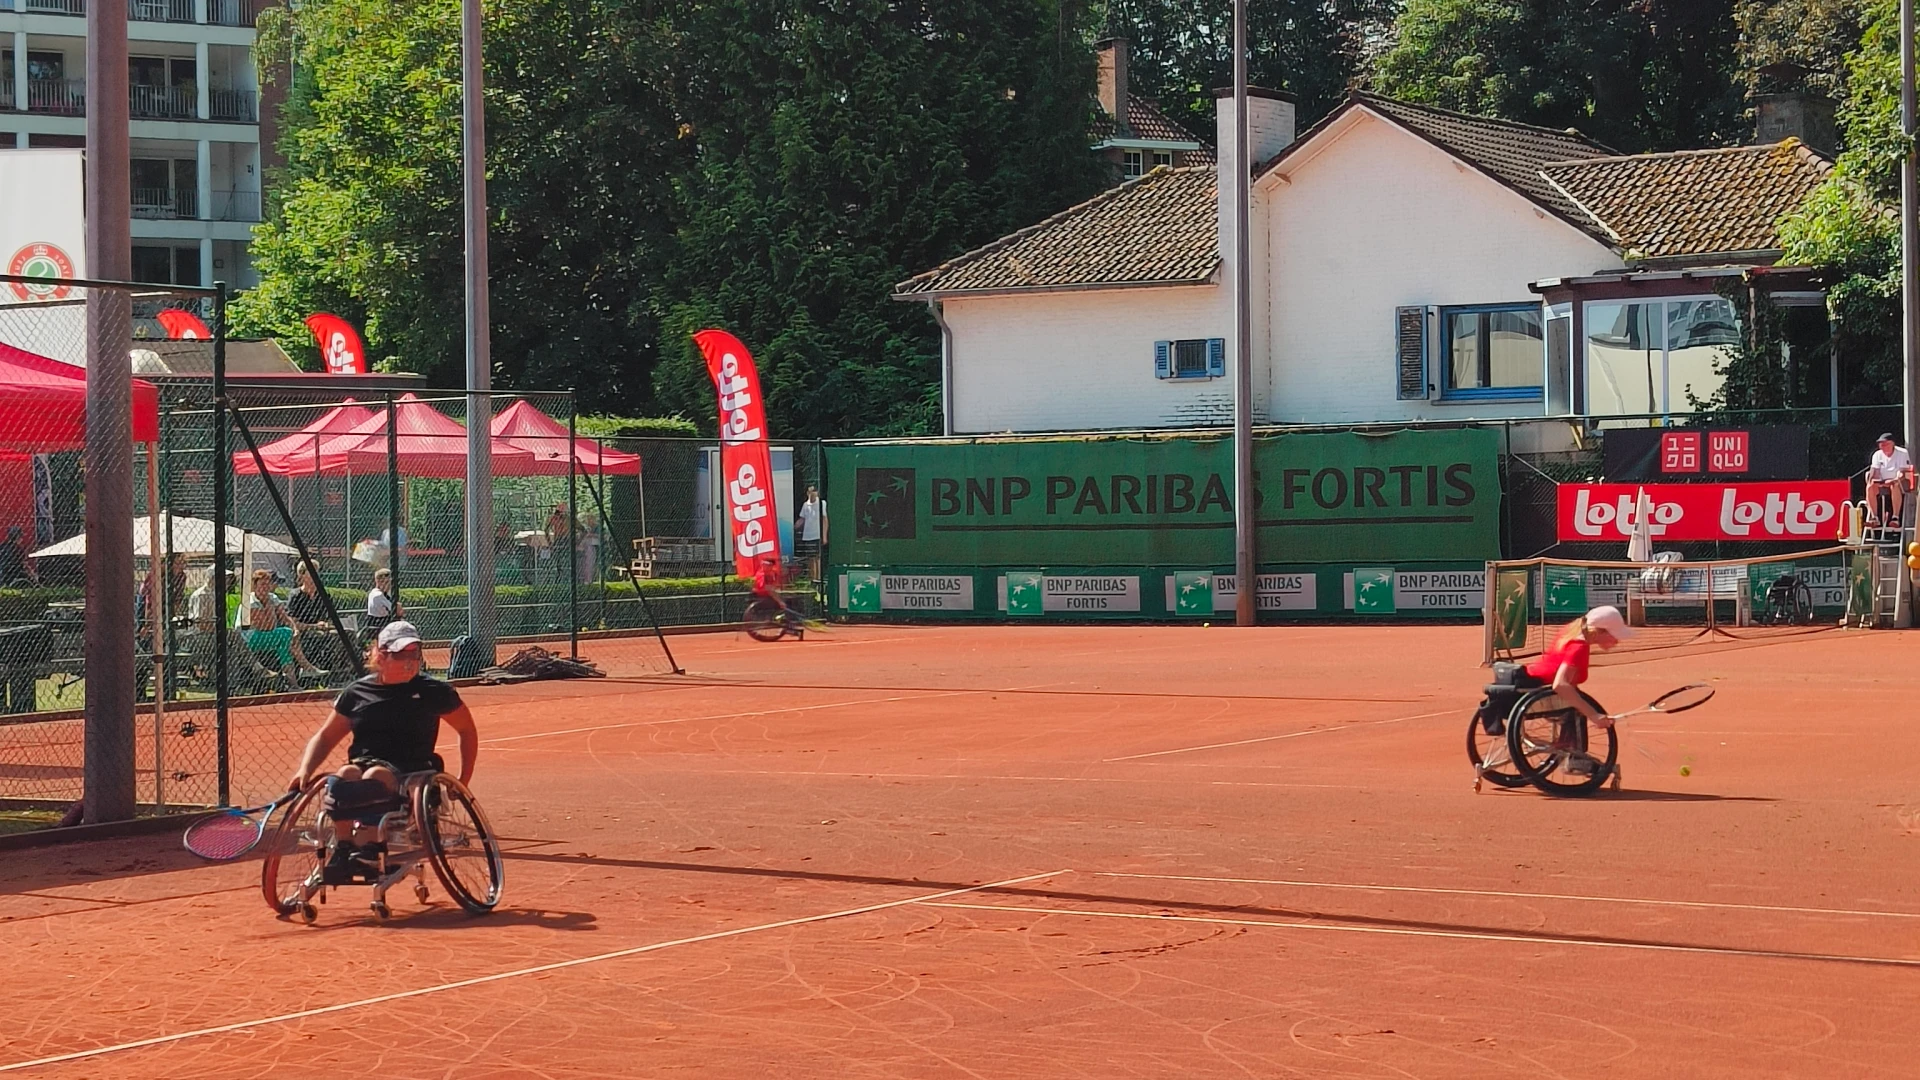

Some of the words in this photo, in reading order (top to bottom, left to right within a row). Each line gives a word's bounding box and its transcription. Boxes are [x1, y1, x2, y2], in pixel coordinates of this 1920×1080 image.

[1713, 436, 1741, 451] UNI
[1713, 453, 1743, 469] QLO
[932, 477, 1030, 516] BNP
[1283, 463, 1476, 510] FORTIS
[1399, 575, 1428, 588] BNP
[1592, 573, 1623, 586] BNP
[1800, 569, 1833, 584] BNP
[885, 578, 909, 590] BNP
[912, 578, 961, 591] PARIBAS
[1047, 579, 1072, 591] BNP
[1075, 579, 1127, 591] PARIBAS
[1217, 578, 1236, 591] BN
[1255, 576, 1303, 590] ARIBAS
[904, 596, 943, 607] FORTIS
[1066, 597, 1108, 609] FORTIS
[1256, 596, 1282, 608] RTIS
[1421, 594, 1468, 606] FORTIS
